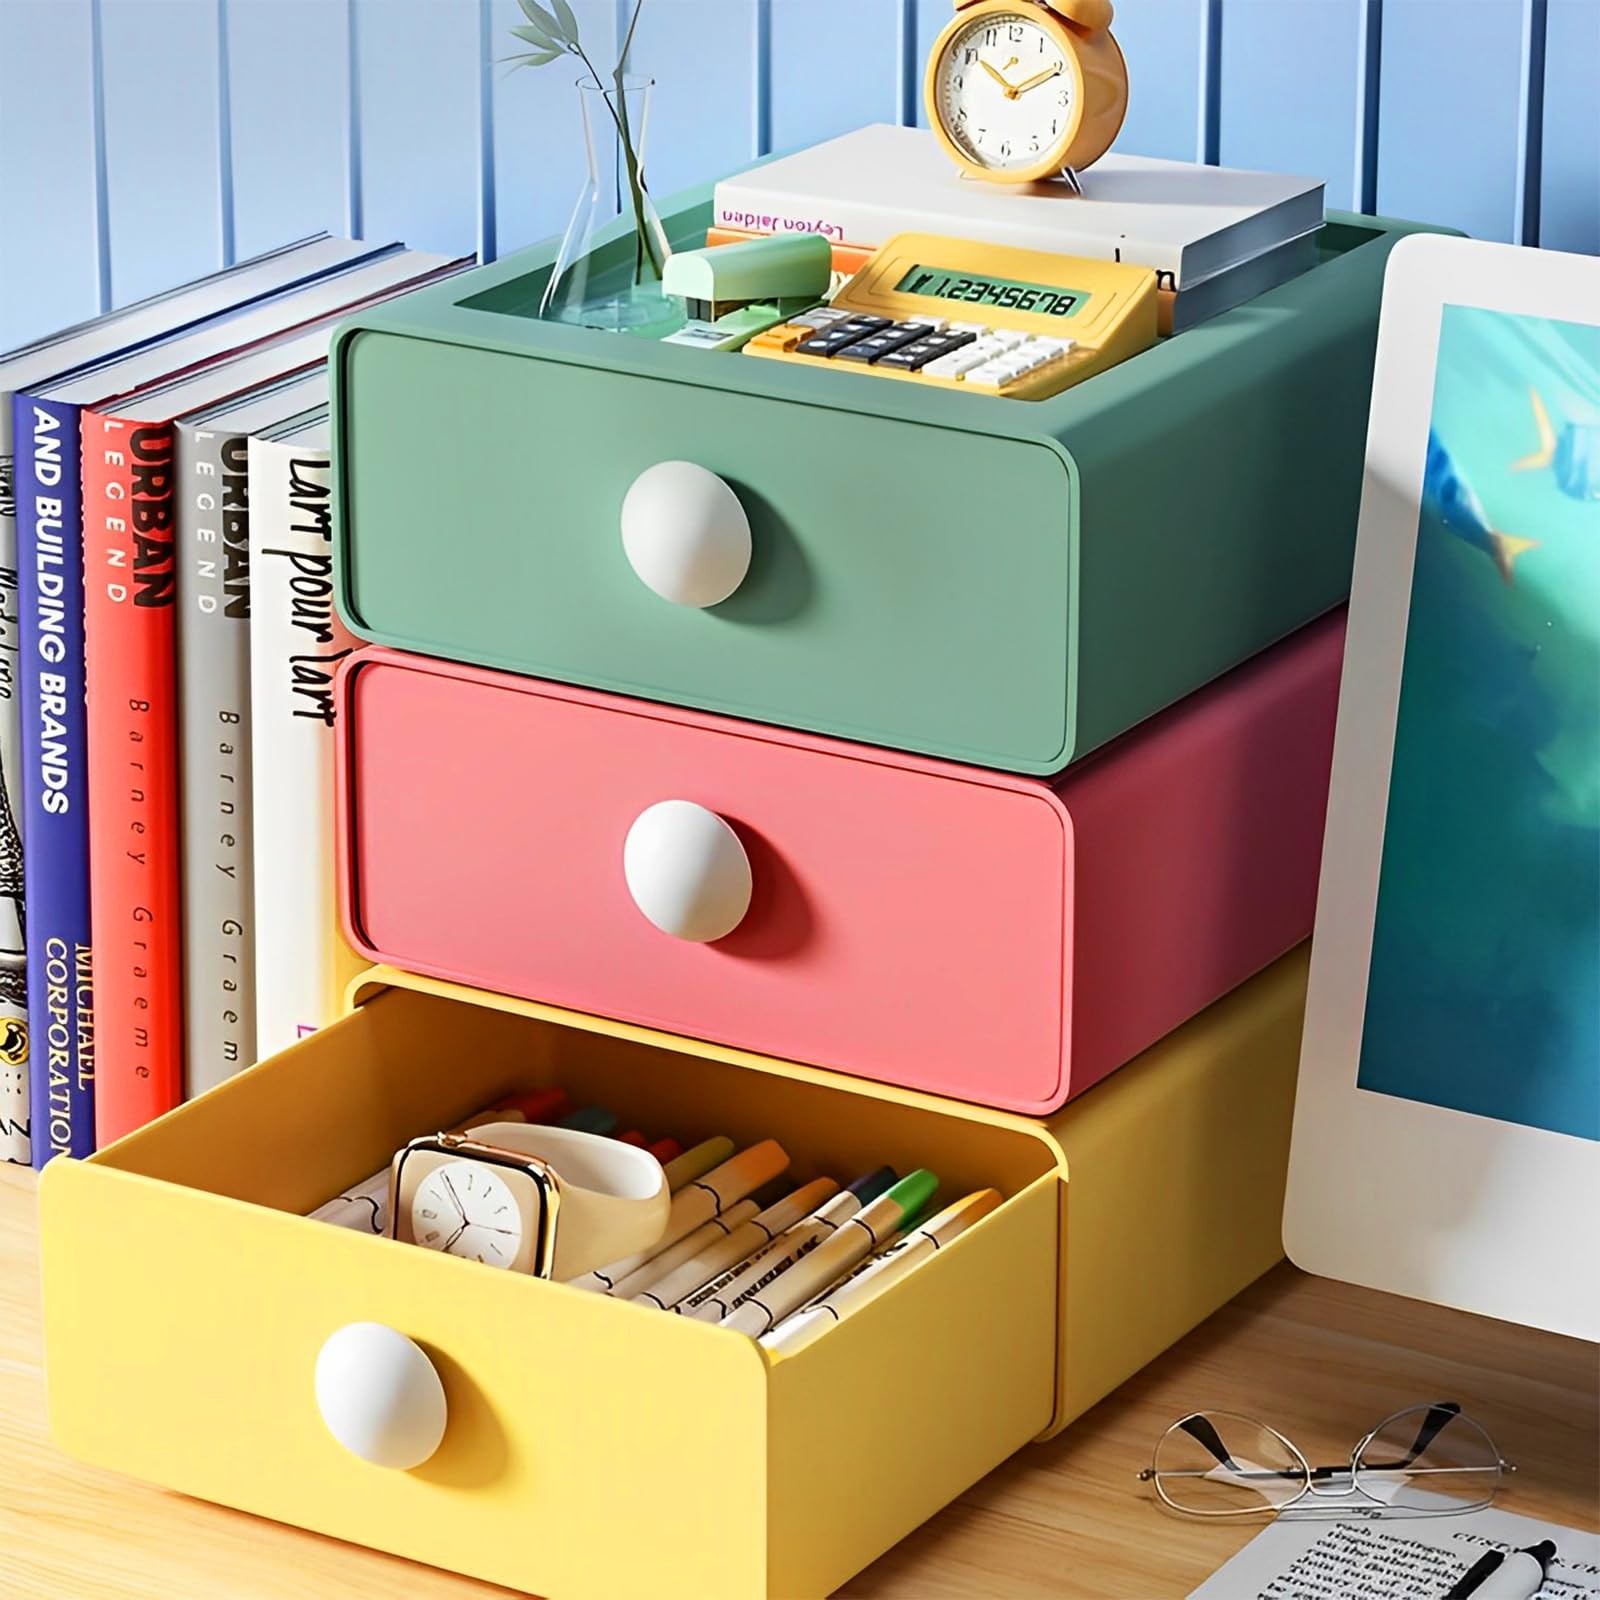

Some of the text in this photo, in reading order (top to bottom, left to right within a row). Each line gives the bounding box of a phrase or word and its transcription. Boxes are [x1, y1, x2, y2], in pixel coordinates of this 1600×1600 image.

[985, 28, 997, 47] 11
[1008, 25, 1023, 43] 12
[1058, 90, 1068, 107] 3
[978, 128, 986, 145] 7
[104, 420, 127, 603] LEGEND
[130, 427, 173, 609] URBAN
[194, 430, 217, 614] LEGEND
[220, 437, 250, 619] URBAN
[261, 548, 333, 643] pour
[33, 406, 69, 814] AND BUILDING BRANDS
[215, 710, 240, 879] Barney
[127, 699, 154, 1080] Barney Graeme
[75, 943, 95, 1092] MICHAEL
